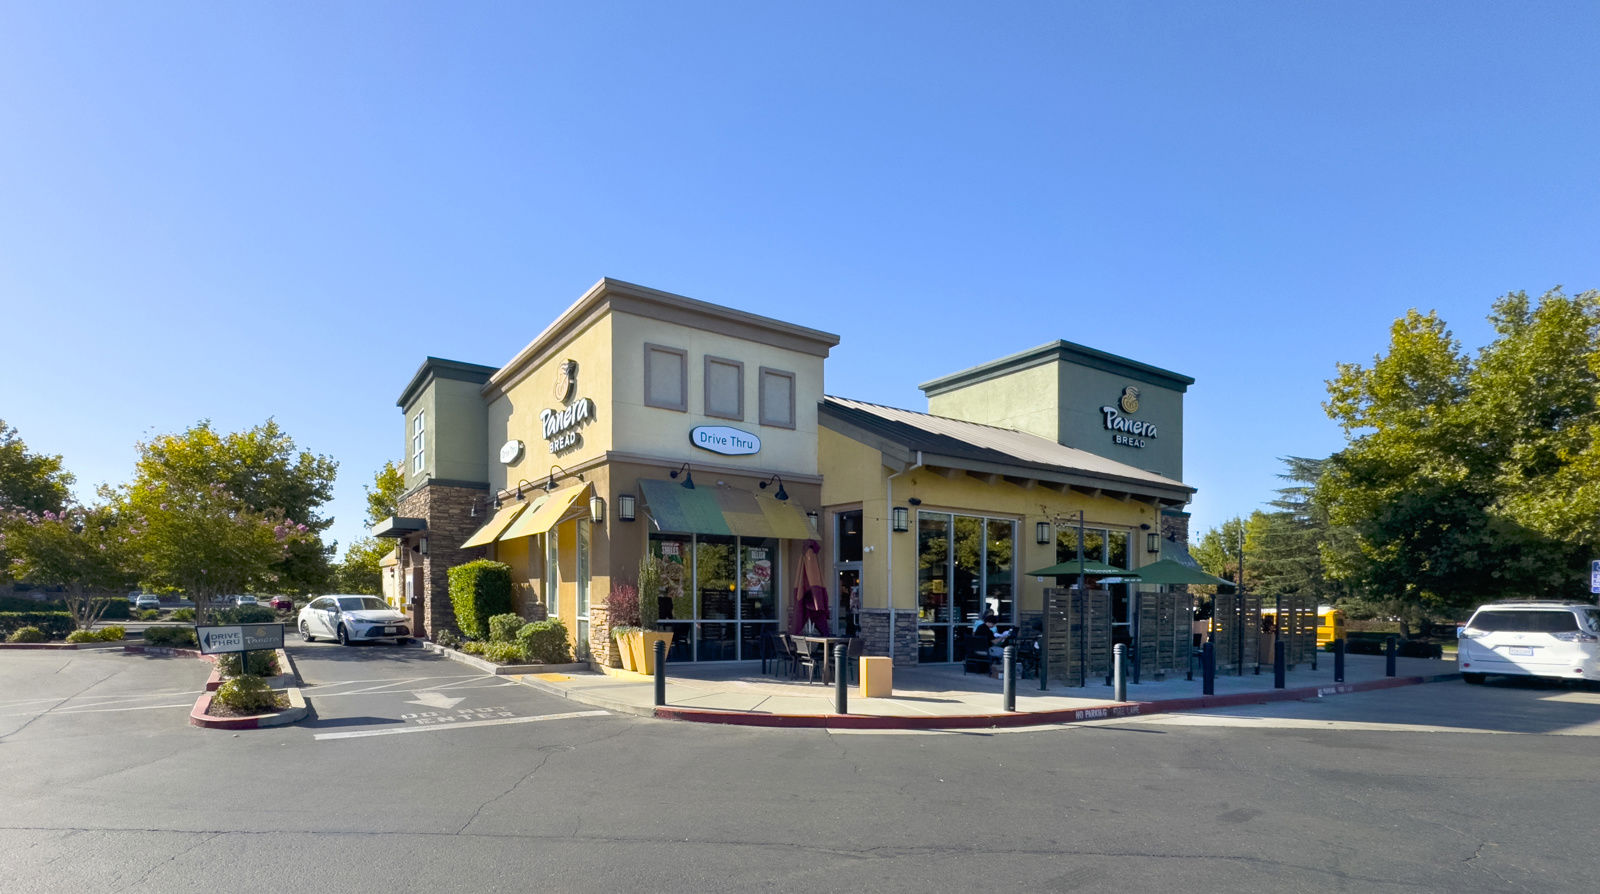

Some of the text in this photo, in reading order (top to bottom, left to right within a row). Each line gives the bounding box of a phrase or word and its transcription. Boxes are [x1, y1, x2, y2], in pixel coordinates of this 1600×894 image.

[540, 397, 589, 440] Panera
[1103, 406, 1158, 438] Panera
[549, 431, 577, 454] BREAD
[700, 431, 753, 449] Drive Thru
[1116, 434, 1146, 448] BREAD
[211, 632, 240, 641] DRIVE
[1075, 710, 1083, 720] NO
[1085, 708, 1107, 719] PARKING
